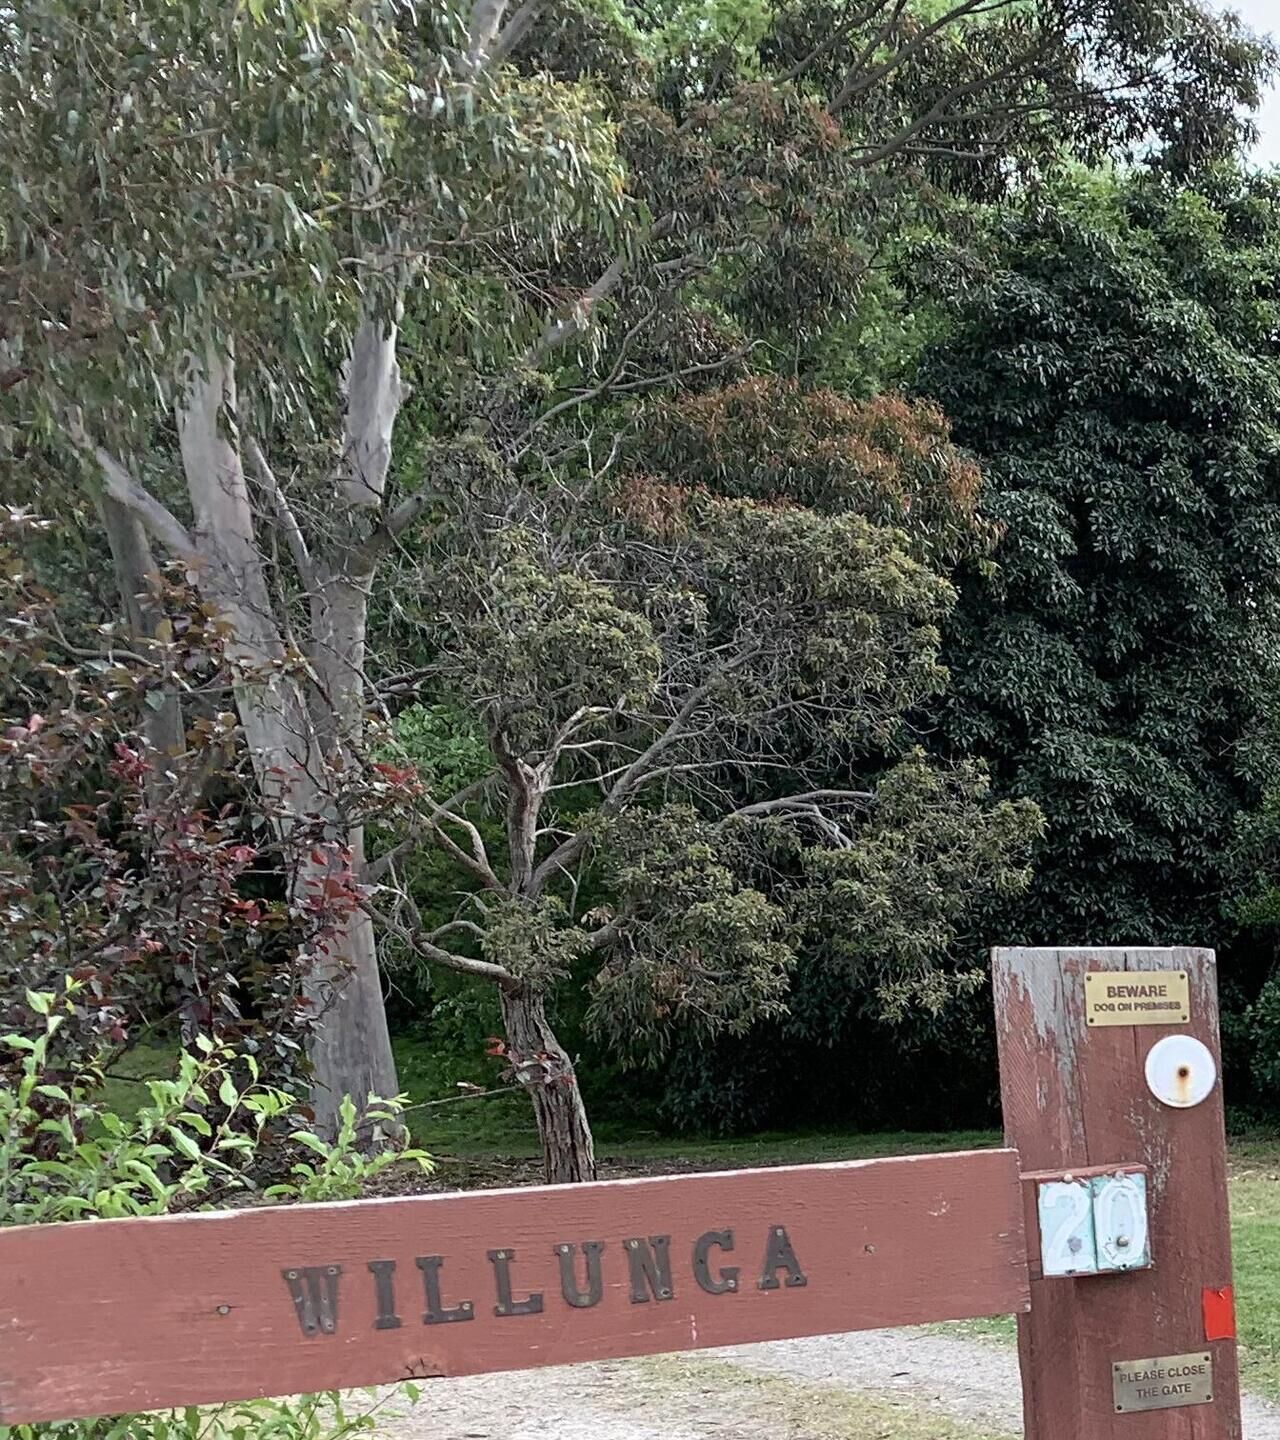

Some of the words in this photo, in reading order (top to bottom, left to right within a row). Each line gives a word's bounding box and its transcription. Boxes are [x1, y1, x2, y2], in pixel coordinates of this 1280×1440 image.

[1106, 985, 1168, 998] BEWARE
[1093, 1003, 1116, 1012] DOG
[1117, 1002, 1132, 1011] ON
[1134, 1001, 1182, 1011] PREMISES
[1042, 1177, 1147, 1273] 20
[280, 1224, 808, 1337] WILLUNGA
[1120, 1369, 1165, 1384] PLEASE
[1167, 1364, 1206, 1378] CLOSE
[1136, 1386, 1159, 1399] THE
[1161, 1382, 1193, 1396] GATE
